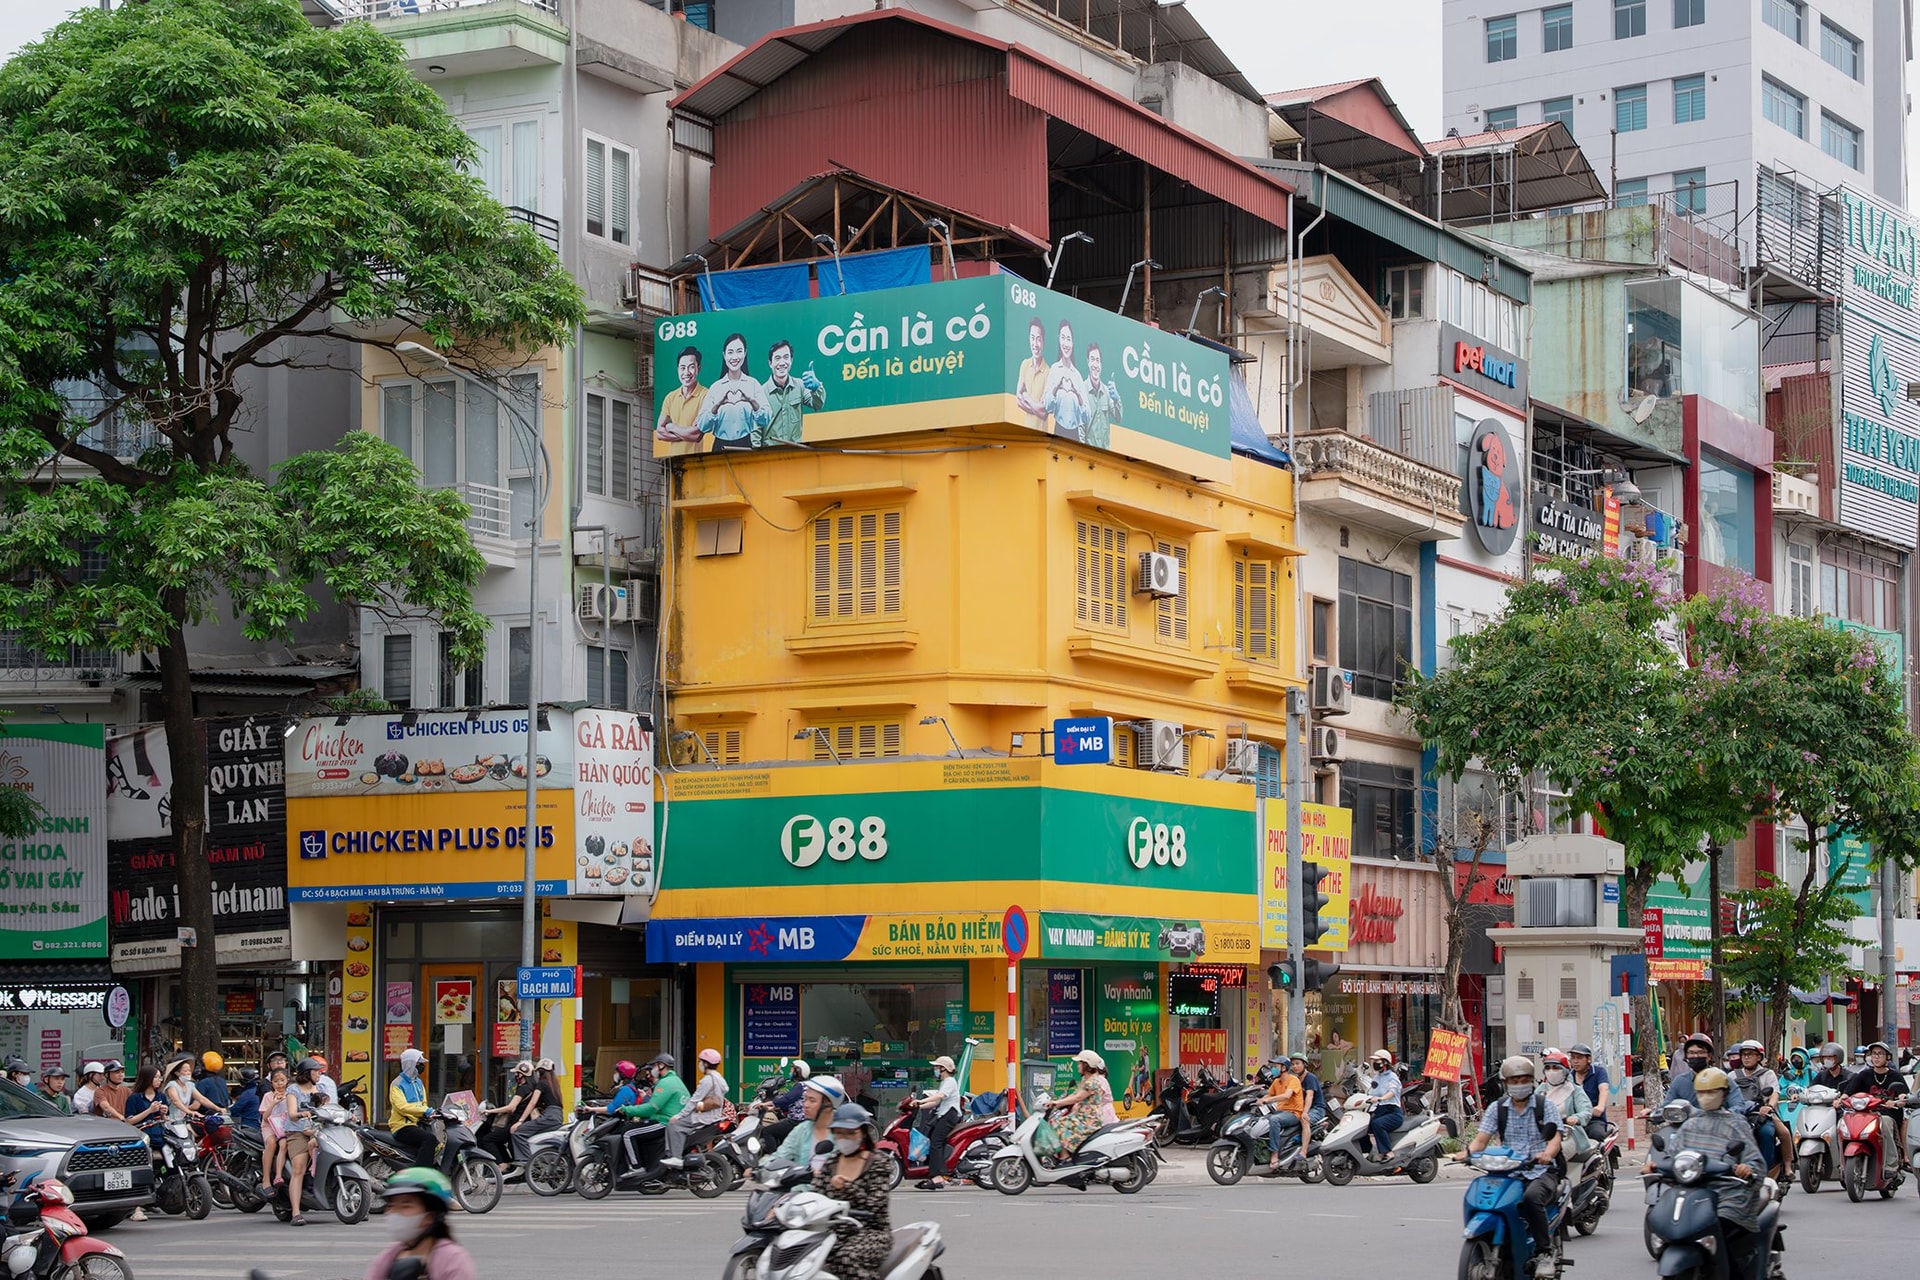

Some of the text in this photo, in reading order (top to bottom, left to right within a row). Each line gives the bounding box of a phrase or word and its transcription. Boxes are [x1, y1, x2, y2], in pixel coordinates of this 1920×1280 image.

[1854, 264, 1870, 290] 160
[1872, 272, 1892, 299] PHỐ
[818, 302, 991, 356] Cần là có
[842, 350, 965, 381] Đến là duyệt
[1122, 340, 1222, 407] Cần là có
[1456, 340, 1517, 389] petmart
[1139, 390, 1209, 433] Đến là duyệt
[1885, 427, 1920, 473] YON
[1541, 500, 1561, 528] CẮT
[1578, 516, 1601, 540] LÔNG
[1539, 533, 1557, 554] SPA
[407, 720, 508, 736] CHICKEN PLUS
[578, 714, 650, 752] GÀ RÁN
[302, 723, 364, 762] Chicken
[1080, 737, 1103, 751] MB
[210, 756, 284, 794] QUỲNH
[579, 758, 650, 787] HÀN QUỐC
[227, 798, 269, 824] LAN
[580, 789, 616, 817] Chicken
[42, 817, 88, 833] SINH
[332, 825, 554, 854] CHICKEN PLUS 0515
[780, 814, 888, 868] F88
[1128, 816, 1187, 869] F88
[1322, 835, 1330, 858] IN
[22, 844, 67, 860] HOA
[14, 867, 84, 889] VAI GÁY
[112, 881, 284, 924] Made ietnam
[302, 889, 314, 897] ĐC:
[315, 888, 324, 898] SỐ
[325, 888, 330, 896] 4
[330, 888, 349, 899] BẠCH
[350, 888, 363, 896] MAI
[368, 888, 380, 896] HAI
[381, 887, 390, 896] BÀ
[391, 887, 415, 895] TRƯNG
[431, 887, 444, 896] NỘI
[1643, 911, 1658, 921] SỬA
[675, 927, 815, 950] ĐIỂM ĐẠI LÝ MB
[889, 914, 1001, 942] BÁN BẢO HIỂM
[1048, 927, 1063, 945] VAY
[1065, 928, 1094, 946] NHANH
[1104, 928, 1125, 947] ĐĂNG
[1128, 928, 1138, 947] KÝ
[1140, 932, 1150, 948] XE
[872, 944, 891, 956] SỨC
[928, 942, 950, 954] NẰM
[954, 942, 977, 957] VIỆN,
[980, 945, 993, 953] TAI
[1220, 939, 1234, 949] 1800
[542, 969, 560, 978] PHỐ
[37, 990, 104, 1008] Massage
[522, 982, 570, 996] BẠCH MAI
[770, 987, 793, 1001] MB
[1064, 986, 1078, 1000] MB
[1104, 984, 1152, 1002] Vay nhanh
[974, 1016, 986, 1025] 02
[1104, 1018, 1152, 1036] Đăng ký xe
[1181, 1033, 1225, 1053] PHOTO-IN
[1432, 1030, 1467, 1048] PHOTO COPY
[1428, 1047, 1448, 1066] CHỤP
